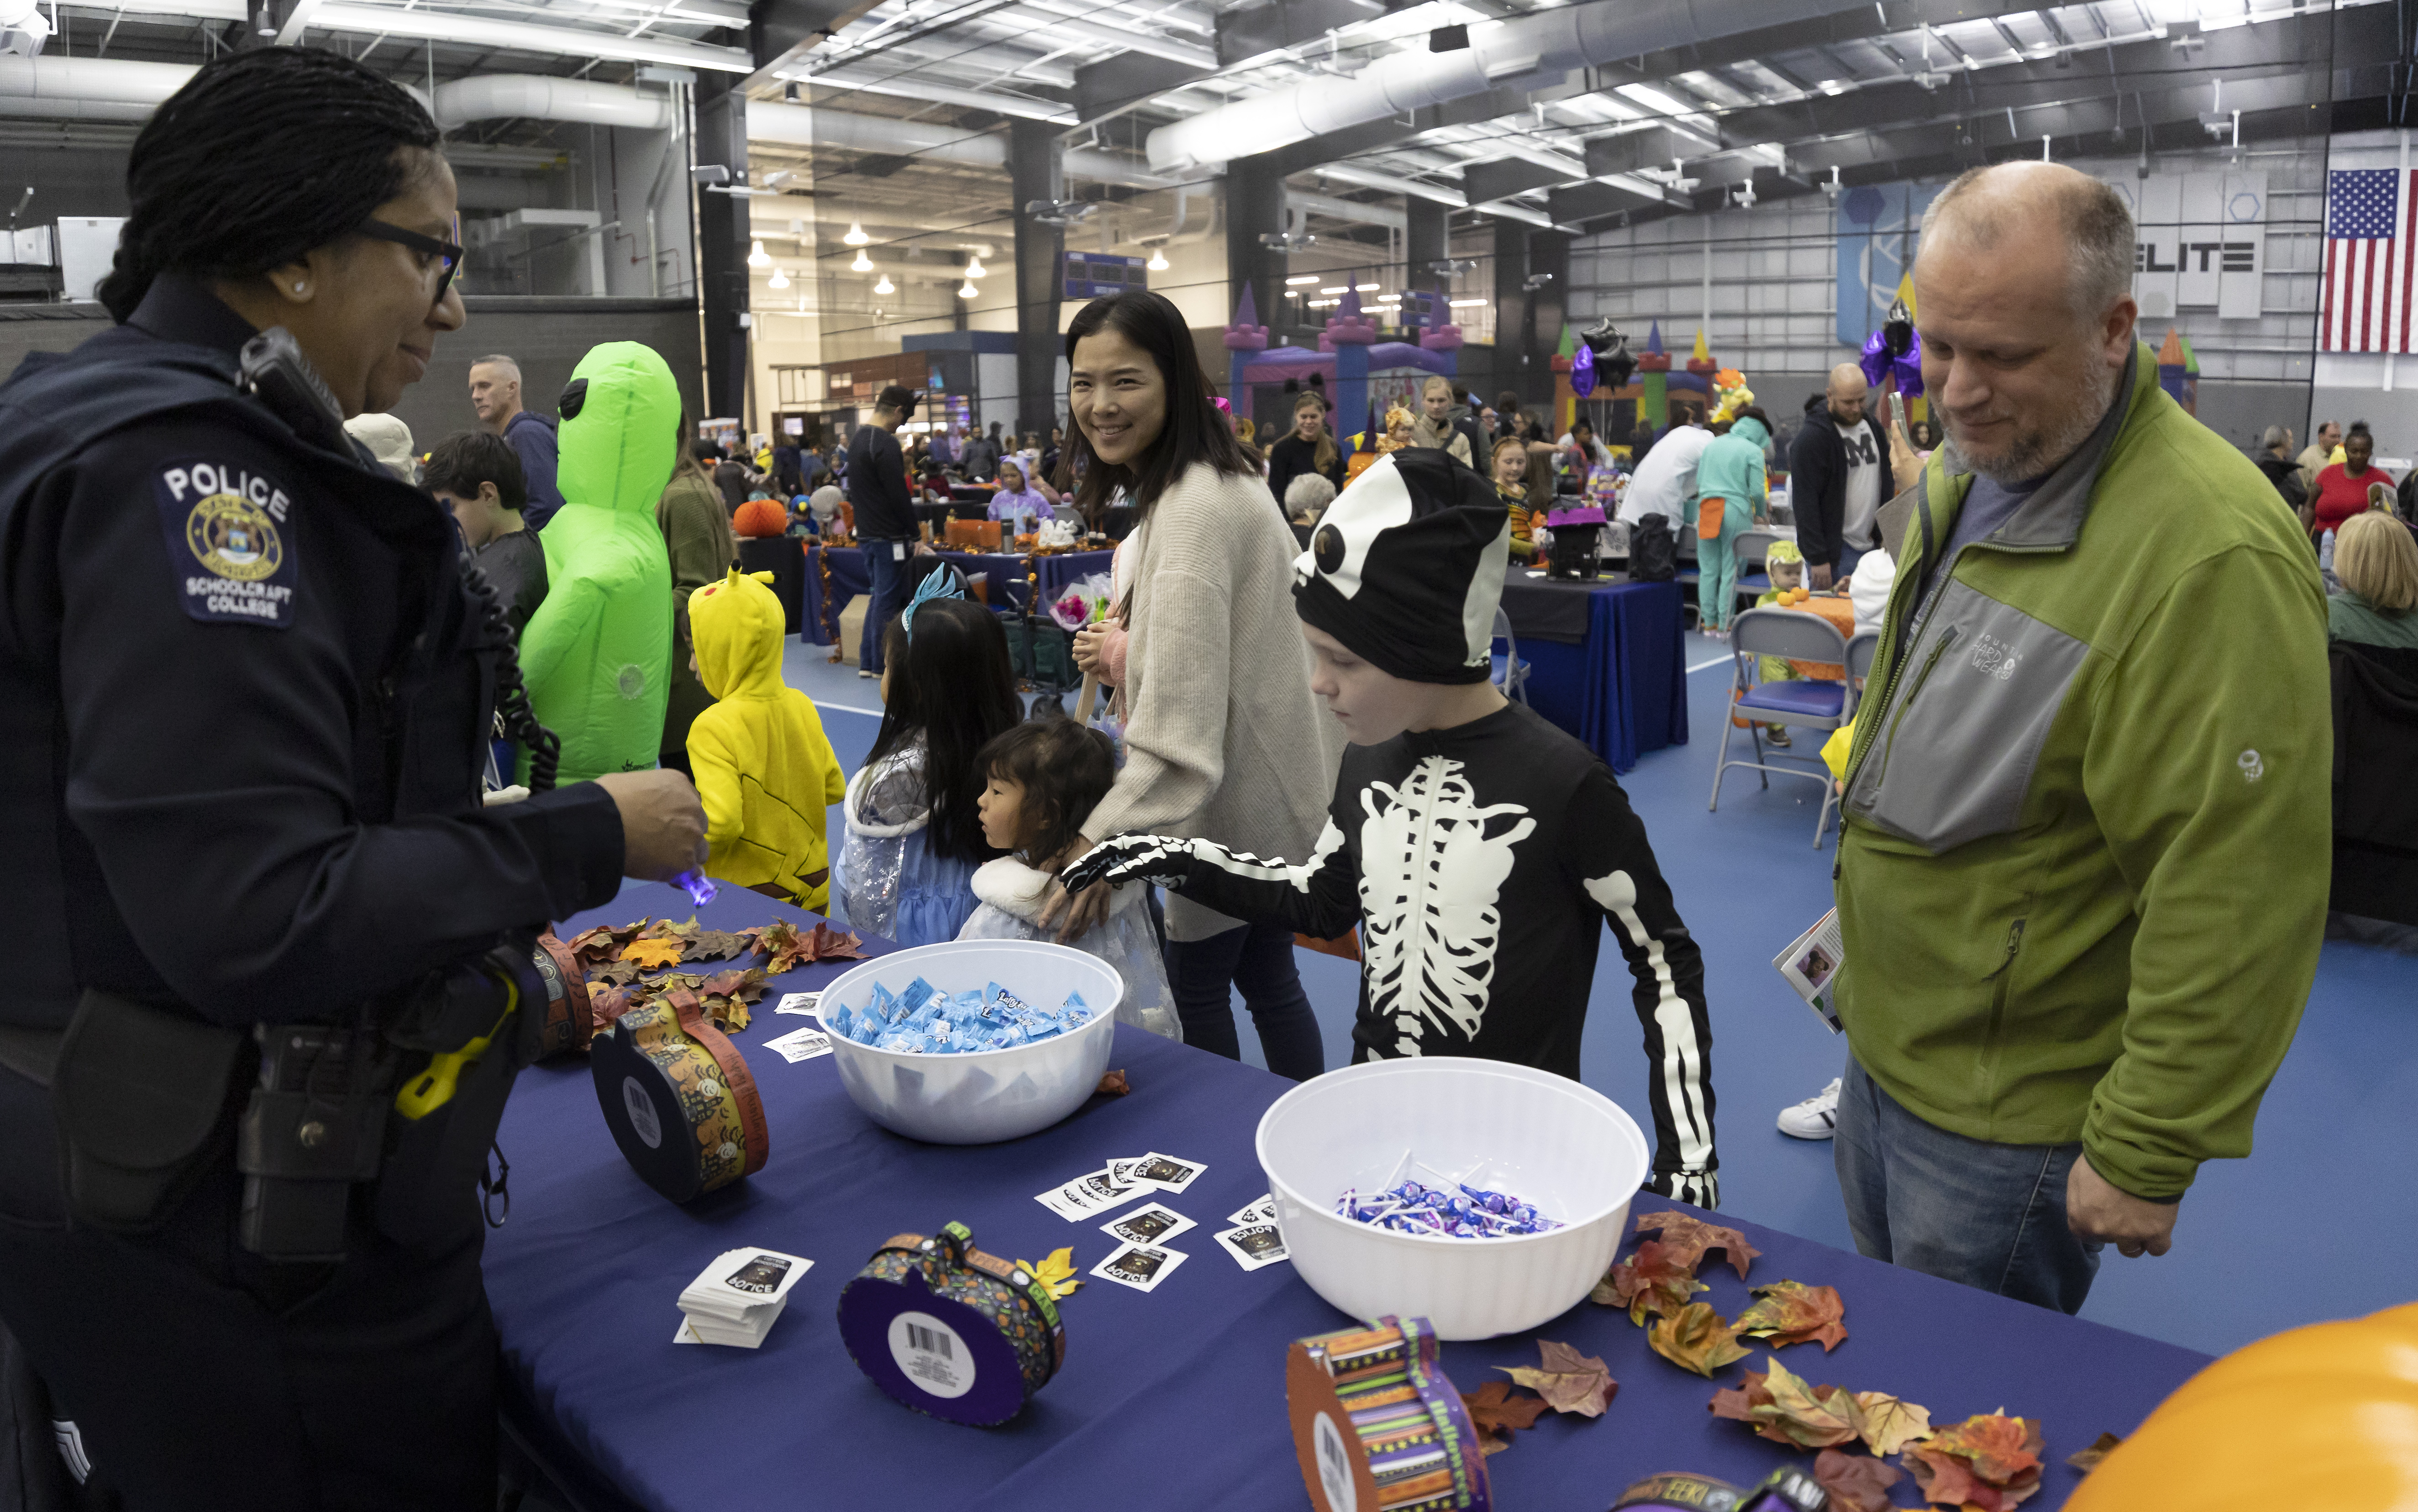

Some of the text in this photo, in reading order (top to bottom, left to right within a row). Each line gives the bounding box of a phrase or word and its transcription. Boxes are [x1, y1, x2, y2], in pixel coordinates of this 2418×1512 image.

[1844, 433, 1877, 467] M
[163, 462, 290, 523] POLICE
[186, 577, 292, 605] SCHOOLCRAFT
[206, 594, 279, 620] COLLEGE
[1972, 641, 2002, 663] HARD
[1972, 649, 2003, 680] WEAR
[997, 991, 1018, 1009] Laffy
[1135, 1157, 1162, 1177] POLICE
[1088, 1177, 1118, 1197] POLICE
[1115, 1223, 1150, 1244] POLICE
[1230, 1225, 1273, 1242] POLICE
[1105, 1264, 1149, 1283] POLICE
[727, 1276, 774, 1293] POLICE
